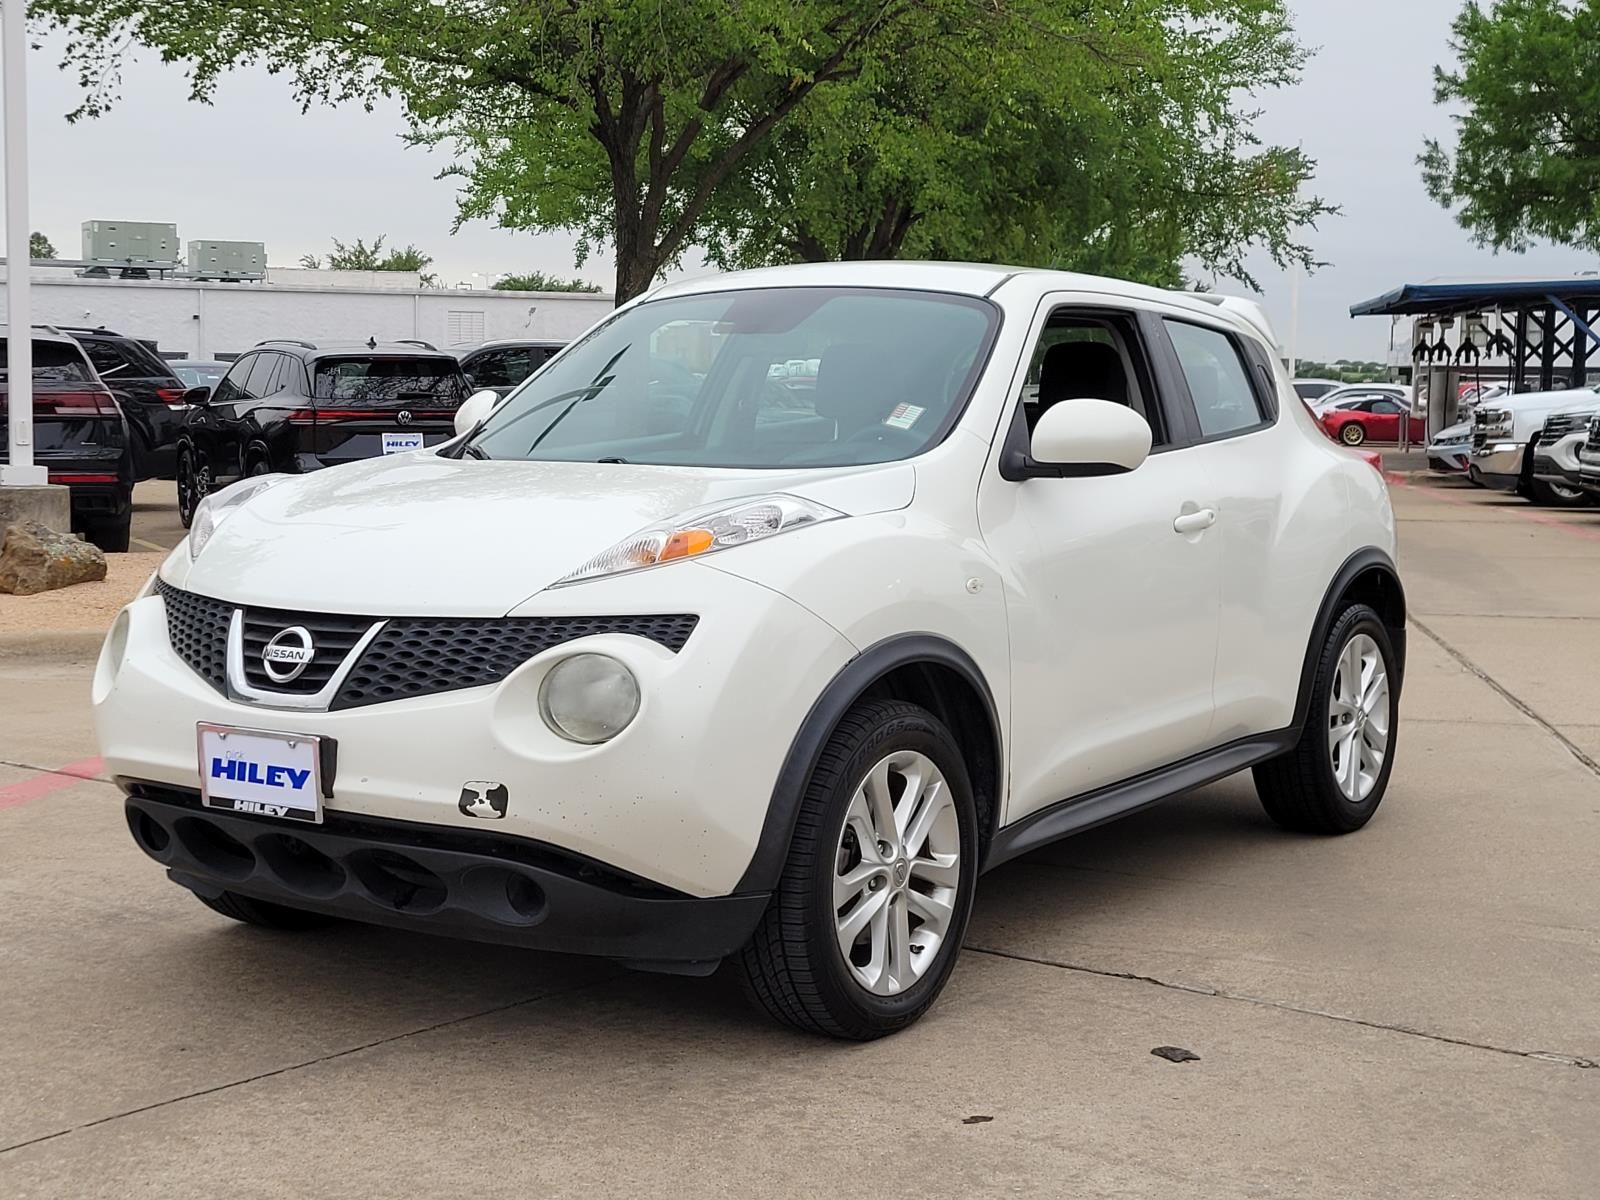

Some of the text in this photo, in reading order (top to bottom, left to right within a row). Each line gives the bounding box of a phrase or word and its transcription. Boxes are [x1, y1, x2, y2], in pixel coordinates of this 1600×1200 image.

[264, 647, 305, 660] NISSAN
[211, 757, 311, 790] HILEY
[234, 799, 289, 817] HILEY
